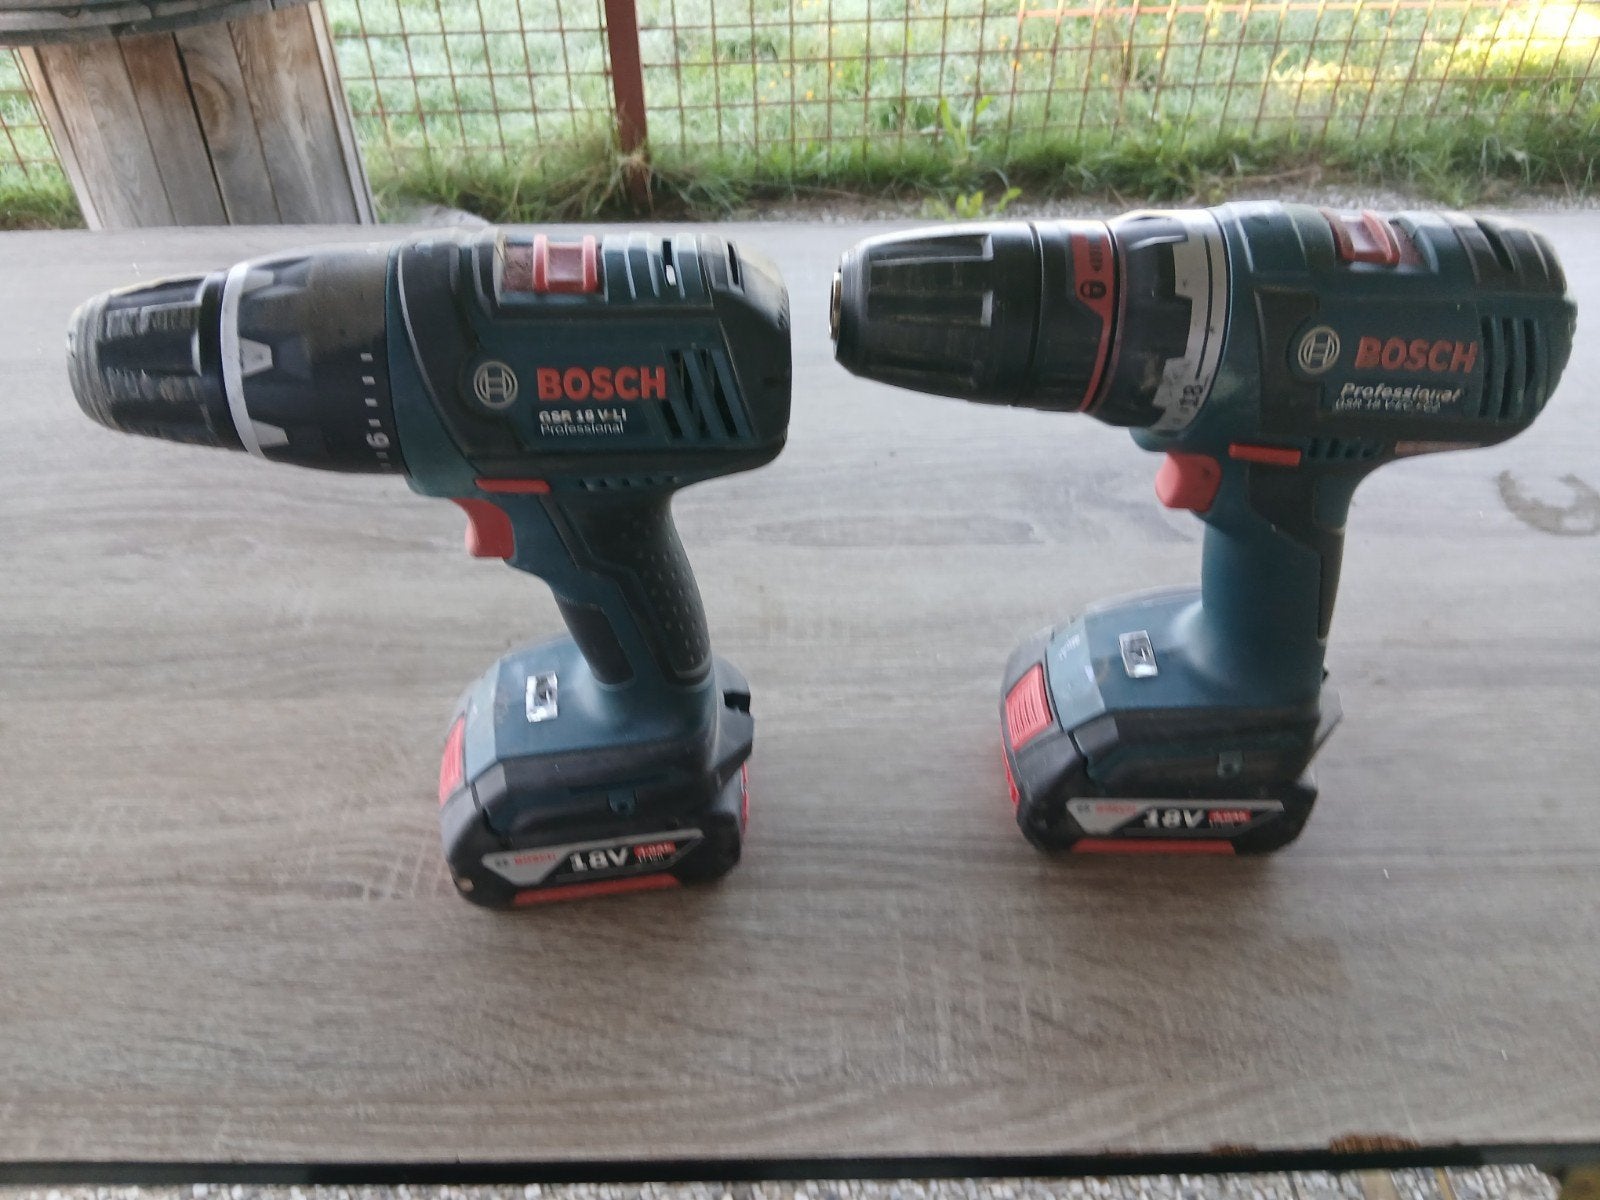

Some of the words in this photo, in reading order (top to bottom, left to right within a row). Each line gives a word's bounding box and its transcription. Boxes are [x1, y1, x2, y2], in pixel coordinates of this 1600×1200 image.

[1354, 335, 1479, 374] BOSCH
[536, 366, 667, 400] BOSCH
[1341, 382, 1464, 402] Professional
[540, 420, 625, 436] Professional
[1143, 809, 1205, 829] 18V
[569, 847, 629, 872] 18V
